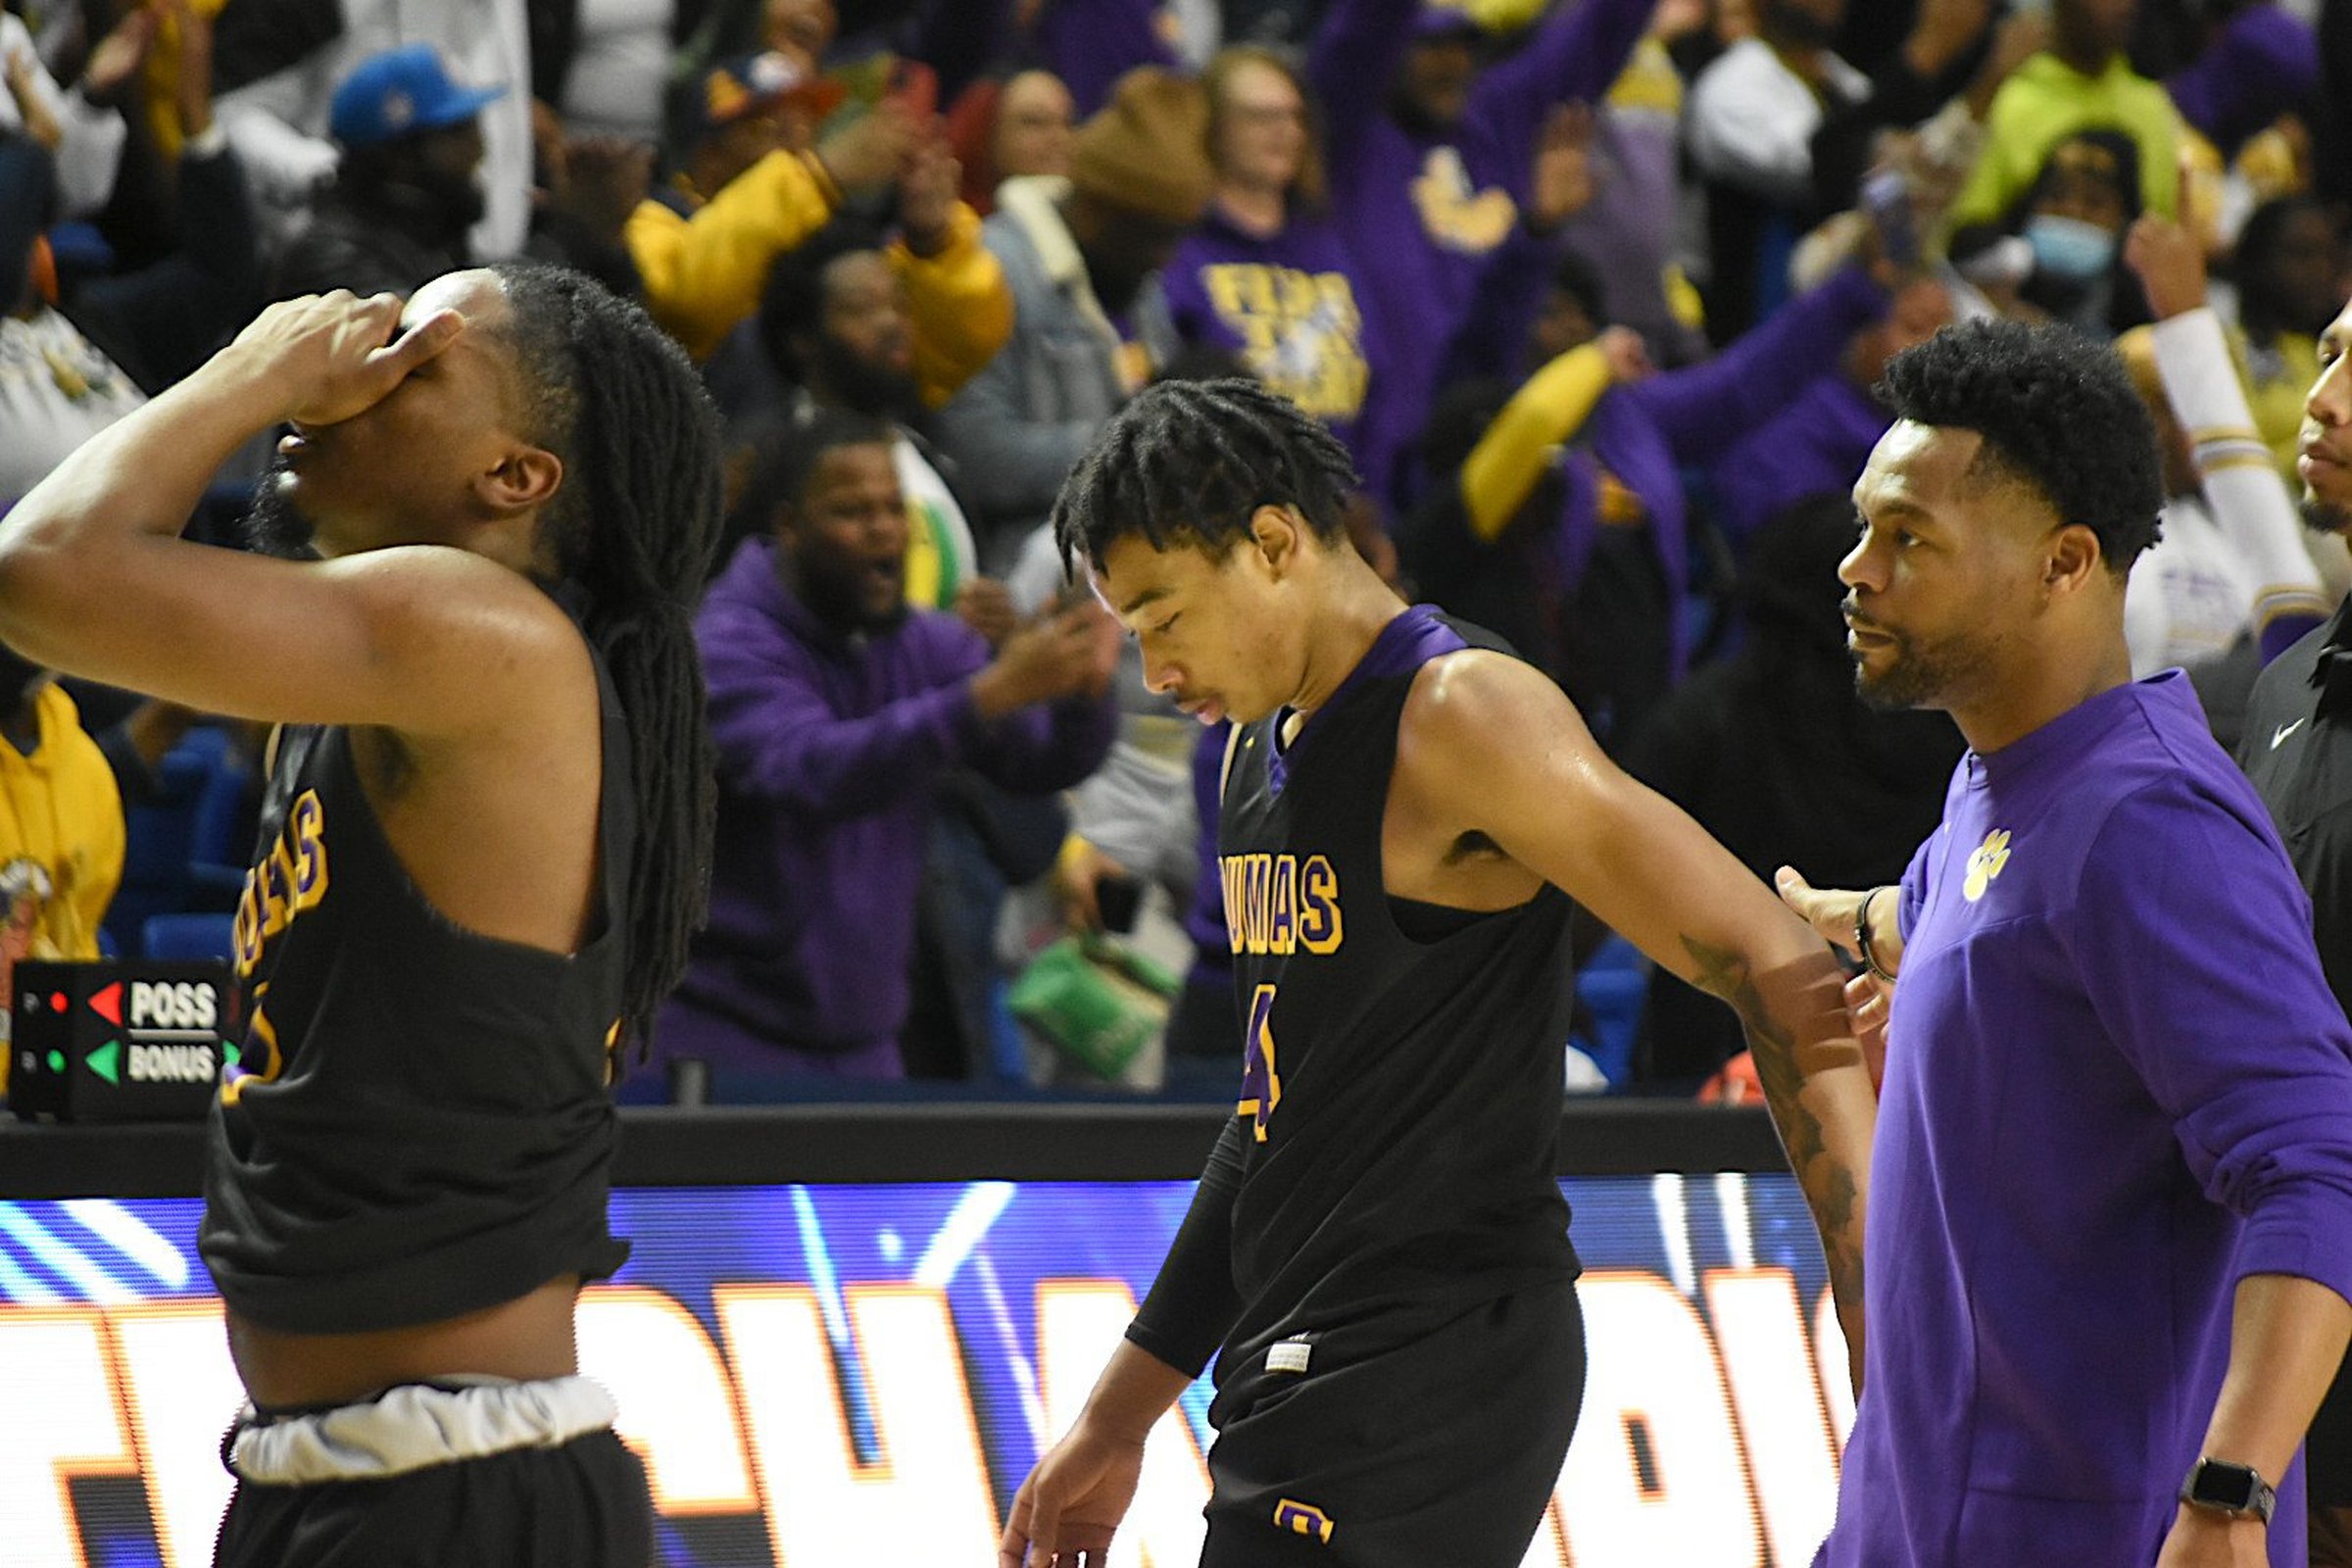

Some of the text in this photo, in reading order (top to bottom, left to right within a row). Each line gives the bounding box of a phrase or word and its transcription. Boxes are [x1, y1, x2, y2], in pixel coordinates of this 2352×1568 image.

[1218, 854, 1344, 955] UMAS
[129, 981, 218, 1028] POSS
[127, 1045, 217, 1083] BONUS
